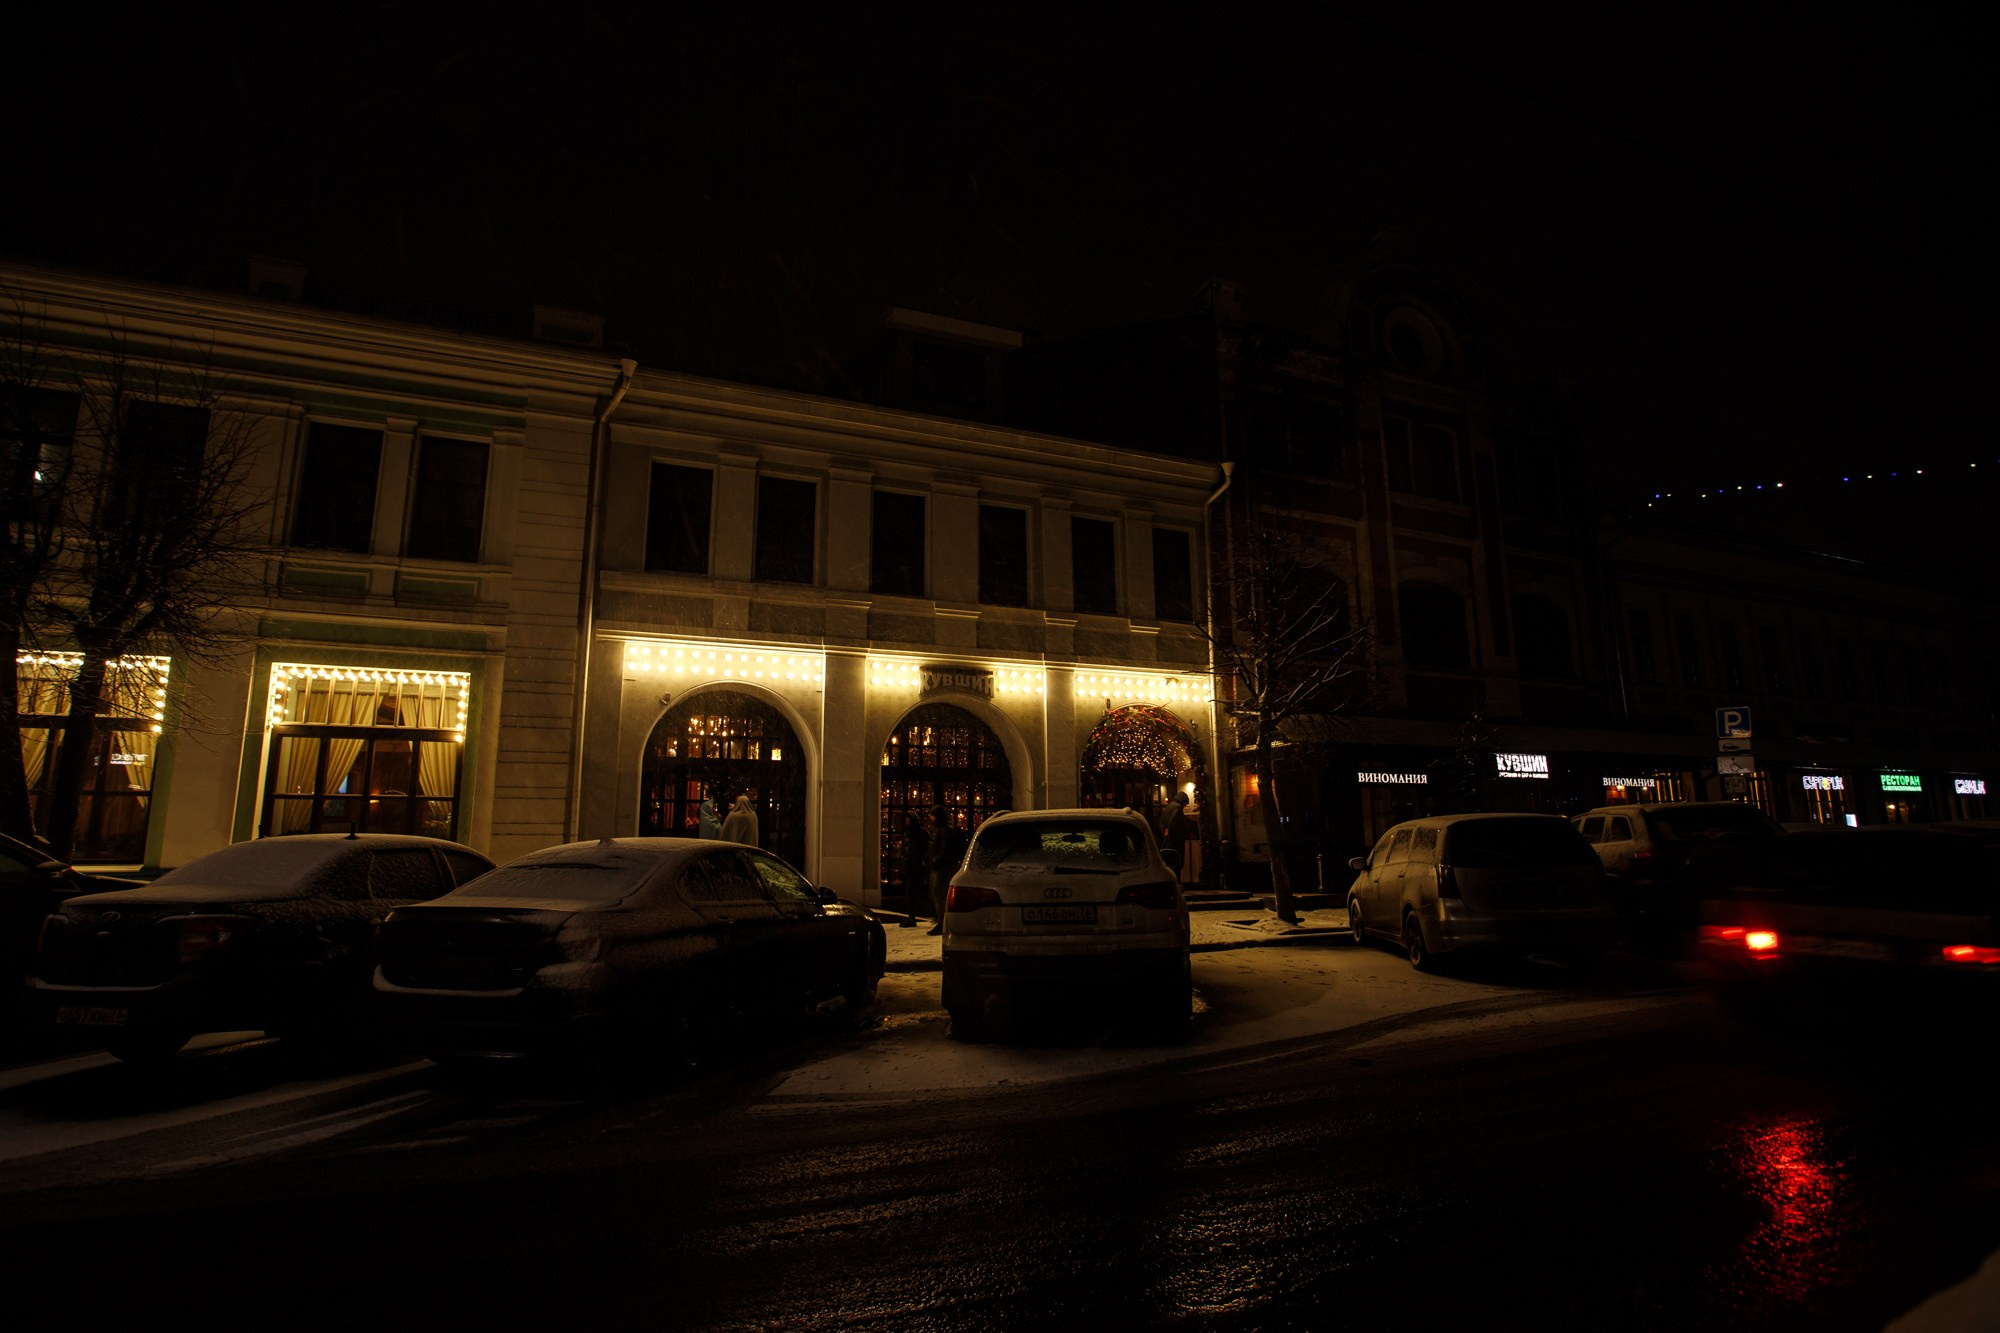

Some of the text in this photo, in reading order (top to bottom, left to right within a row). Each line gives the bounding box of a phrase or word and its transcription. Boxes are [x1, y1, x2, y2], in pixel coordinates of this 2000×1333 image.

[920, 672, 994, 698] КУВШИН
[1496, 754, 1549, 772] КУВШИН
[1357, 772, 1428, 785] ВИНОМАНИЯ
[1602, 777, 1656, 788] ВИНОМАНИЯ
[1880, 775, 1921, 786] РЕСТОРАН
